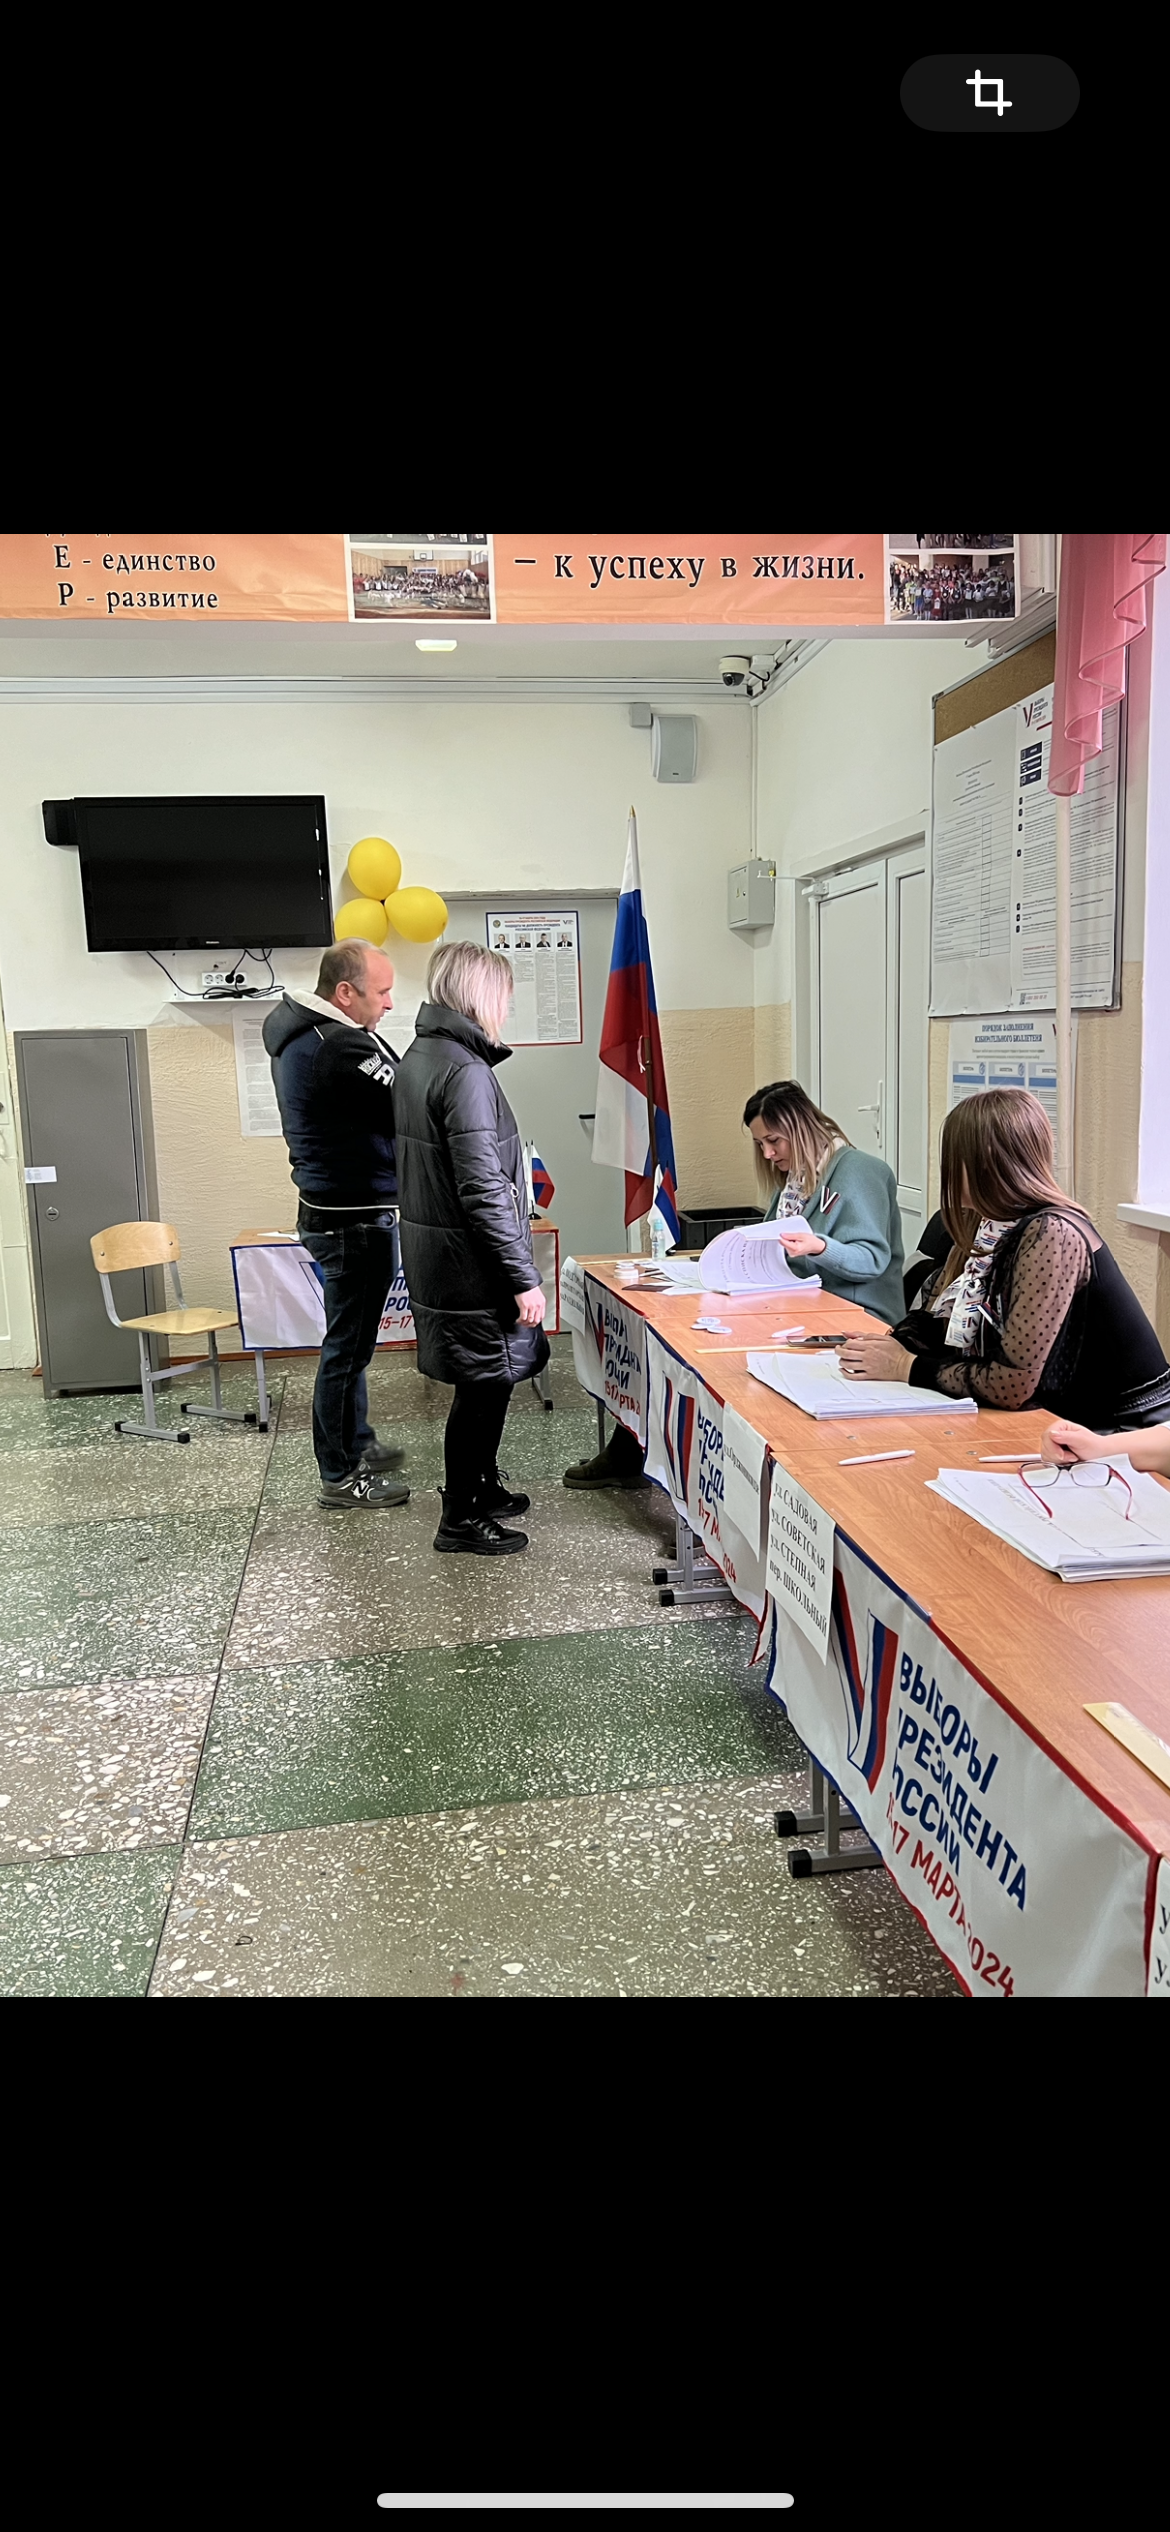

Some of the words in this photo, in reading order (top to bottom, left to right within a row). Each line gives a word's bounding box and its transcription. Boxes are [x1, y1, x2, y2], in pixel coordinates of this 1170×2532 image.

[53, 544, 71, 569] Е
[102, 553, 217, 575] единство
[554, 555, 574, 579] к
[588, 555, 705, 589] успеху
[720, 557, 738, 579] в
[751, 556, 865, 580] жизни.
[57, 582, 75, 607] Р
[106, 590, 219, 614] развитие
[783, 1488, 818, 1536] САДОВАЯ
[780, 1541, 817, 1592] СТЕПНАЯ
[781, 1515, 826, 1575] СОВЕТСКАЯ
[769, 1559, 783, 1582] пер.
[783, 1571, 828, 1638] ШКОЛЬНЫЙ
[910, 1839, 967, 1937] МАРТА
